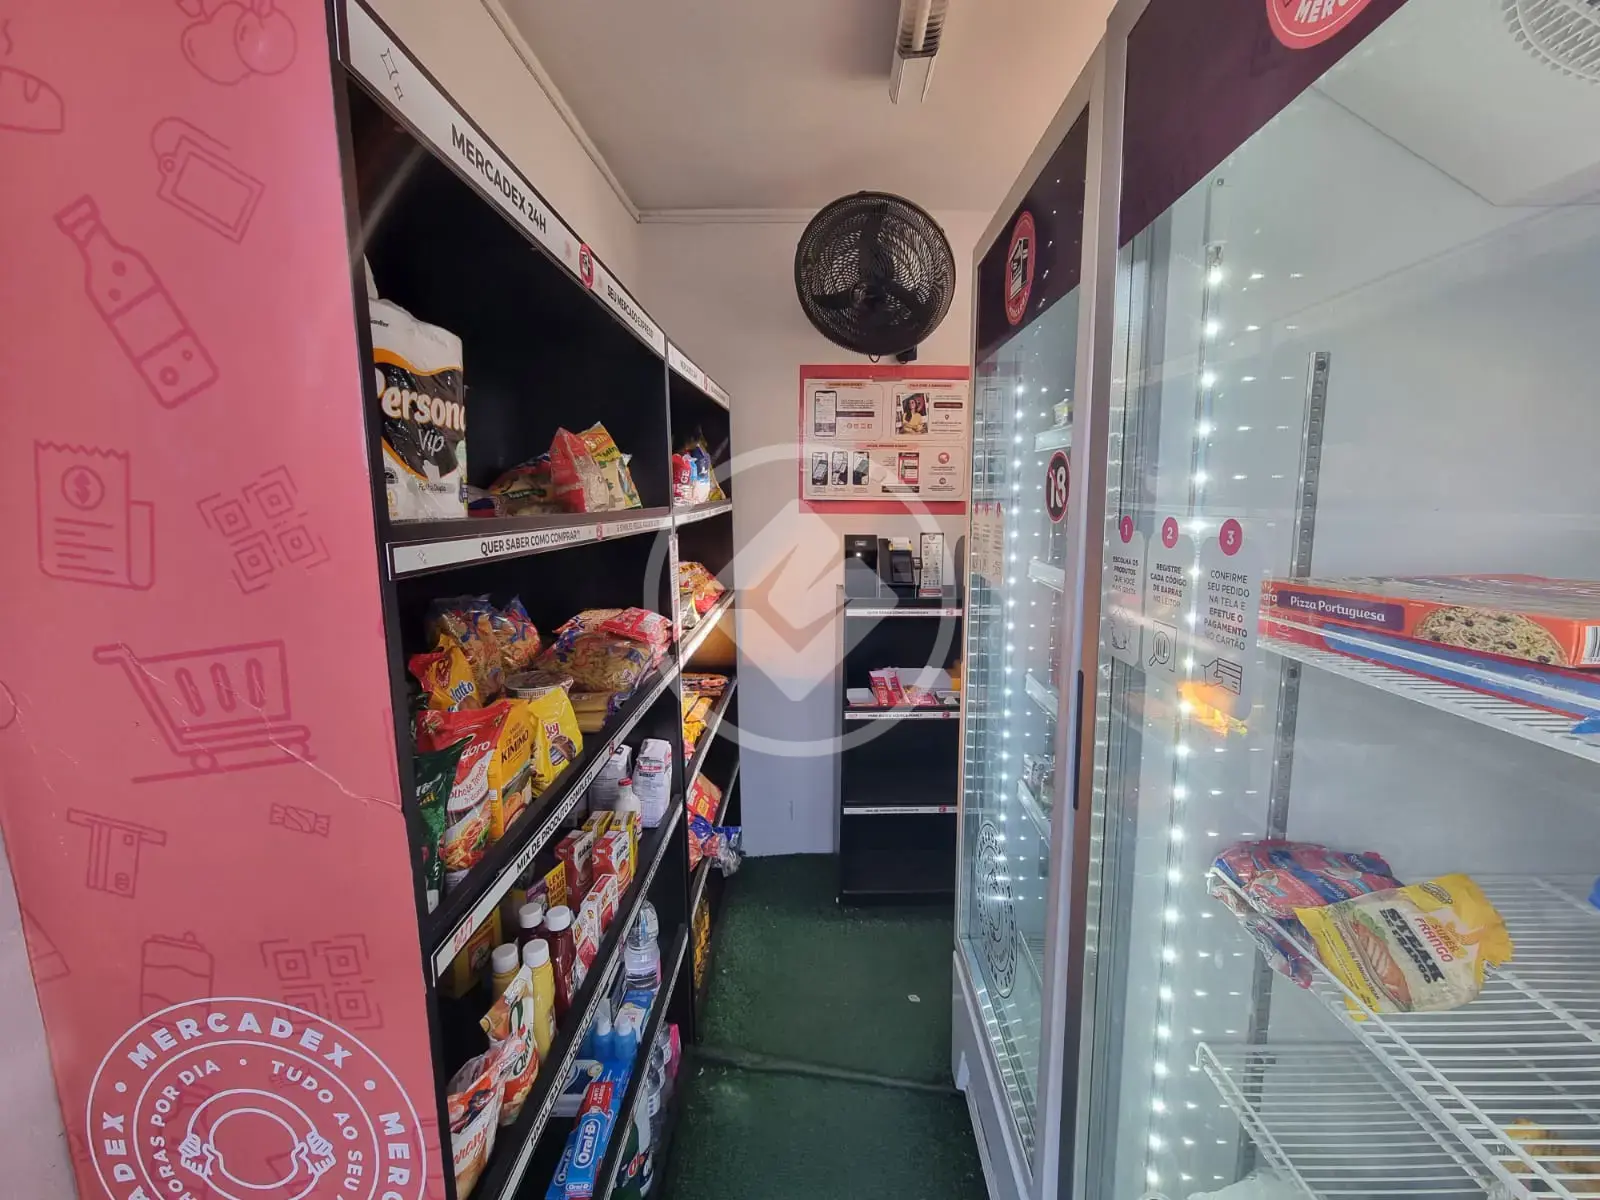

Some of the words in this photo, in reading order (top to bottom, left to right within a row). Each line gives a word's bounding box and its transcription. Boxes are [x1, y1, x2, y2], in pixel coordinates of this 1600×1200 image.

[451, 122, 527, 214] MERCADEX
[527, 201, 548, 235] 24H
[607, 284, 617, 303] SEU
[617, 294, 638, 324] MERCADO
[418, 428, 445, 456] Vip
[1050, 468, 1067, 509] 18
[480, 539, 505, 554] QUER
[505, 536, 531, 551] SABER
[530, 532, 550, 546] COMO
[550, 530, 580, 544] COMPRAR?
[1124, 525, 1128, 535] 1
[1166, 527, 1173, 540] 2
[1226, 530, 1235, 545] 3
[1112, 555, 1131, 565] ESCOLHA
[1132, 559, 1138, 567] OS
[1113, 565, 1136, 576] PRODUTOS
[1156, 563, 1182, 574] REGISTRE
[1150, 572, 1164, 582] CADA
[1165, 574, 1187, 587] CÓDIGO
[1152, 583, 1160, 592] DE
[1160, 585, 1182, 598] BARRAS
[1207, 582, 1220, 592] SEU
[1221, 584, 1250, 598] PEDIDO
[1210, 570, 1248, 584] CONFIRME
[1209, 595, 1219, 605] NA
[1220, 596, 1239, 609] TELA
[1240, 601, 1247, 611] E
[1209, 607, 1236, 622] EFETUE
[1237, 614, 1243, 623] O
[1290, 595, 1317, 610] Pizza
[1318, 600, 1386, 622] Portuguesa
[1203, 617, 1248, 638] PAGAMENTO
[1204, 629, 1215, 640] NO
[1215, 633, 1246, 651] CARTÃO
[516, 852, 531, 873] MIX
[531, 840, 542, 855] DE
[541, 804, 569, 843] PRODUTO
[569, 771, 593, 808] COMPLETO
[1379, 910, 1395, 928] DE
[1391, 929, 1432, 984] FRANGO
[1385, 908, 1445, 982] STEAK
[1414, 917, 1454, 962] FRANGO
[1432, 923, 1459, 953] SUPER
[127, 1012, 353, 1070] MERCADEX
[150, 1085, 181, 1128] POR
[178, 1058, 221, 1087] DIA
[271, 1060, 335, 1104] TUDO
[333, 1112, 359, 1140] AO
[579, 1122, 596, 1164] Oral-B
[343, 1149, 363, 1191] SEU
